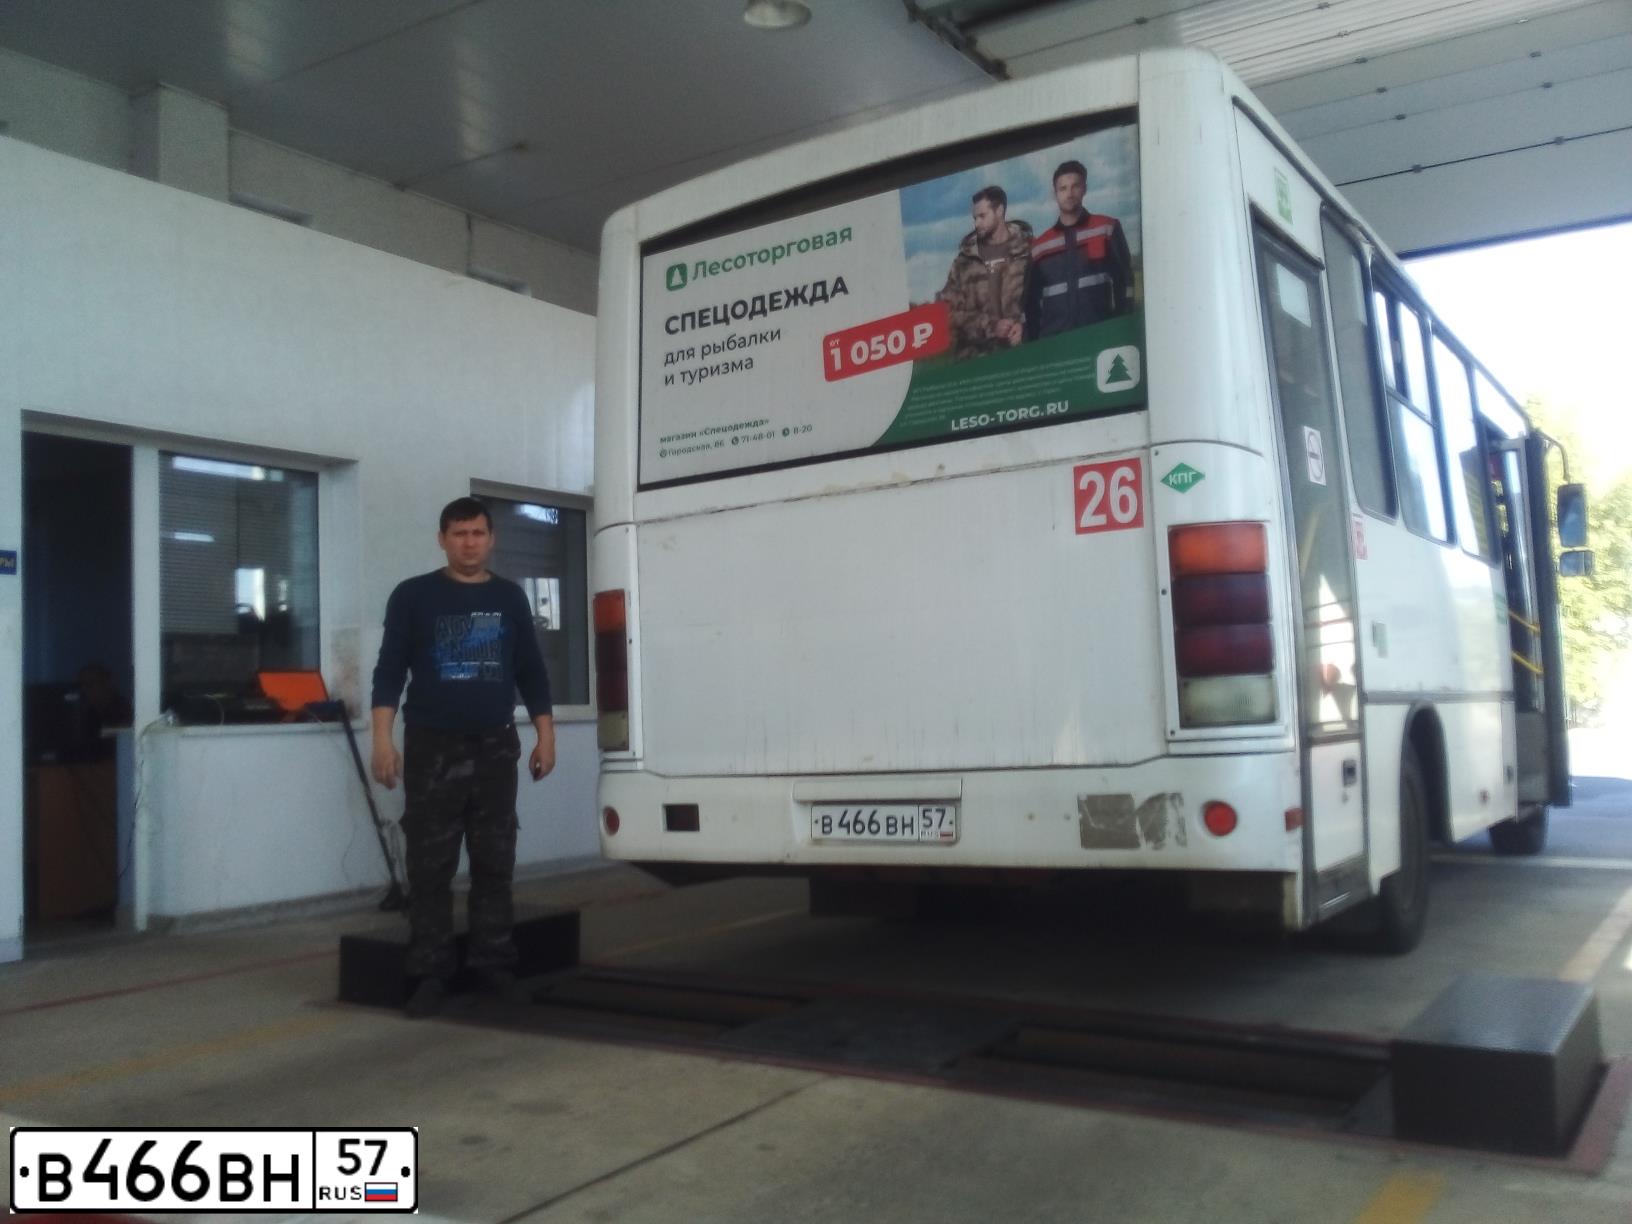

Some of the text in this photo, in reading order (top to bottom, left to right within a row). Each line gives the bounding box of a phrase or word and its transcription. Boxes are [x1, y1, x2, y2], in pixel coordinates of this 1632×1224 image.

[692, 227, 853, 281] Лесоторговая
[665, 276, 849, 335] СПЕЦОДЕЖДА
[664, 328, 781, 367] для рыбалки
[830, 347, 842, 371] 1
[850, 330, 906, 365] 050
[664, 357, 754, 386] и туризма
[951, 400, 1069, 431] LESO-TORG.RU
[660, 431, 697, 444] магазин
[1168, 470, 1197, 486] КПГ
[1079, 466, 1138, 528] 26
[922, 808, 946, 829] 57
